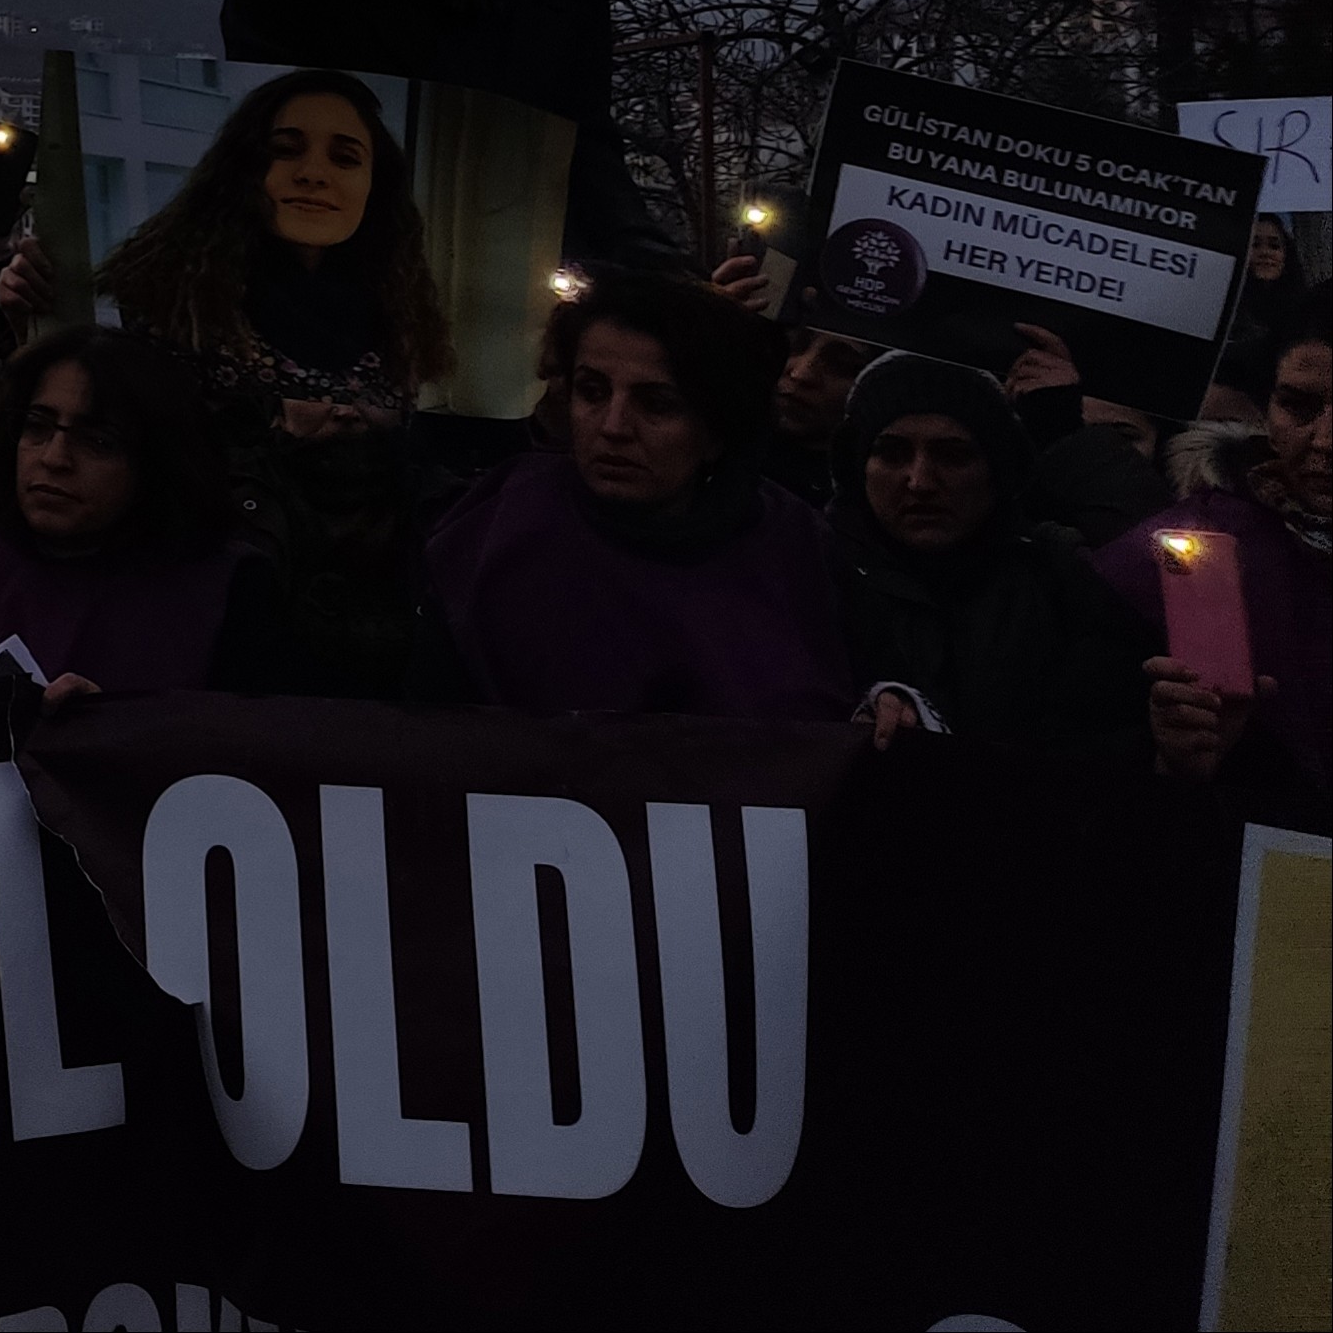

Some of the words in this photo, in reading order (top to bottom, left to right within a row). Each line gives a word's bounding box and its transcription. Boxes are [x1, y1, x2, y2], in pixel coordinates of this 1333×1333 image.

[862, 104, 993, 149] GÜLİSTAN
[995, 133, 1072, 167] DOKU
[1074, 153, 1093, 172] 5
[887, 141, 924, 165] BU
[927, 149, 999, 184] YANA
[1001, 168, 1198, 231] BULUNAMIYOR
[887, 185, 986, 227] KADIN
[992, 210, 1199, 278] MÜCADELESİ
[943, 240, 1008, 271] HER
[1015, 255, 1126, 302] YERDE!
[141, 773, 809, 1208] OLDU
